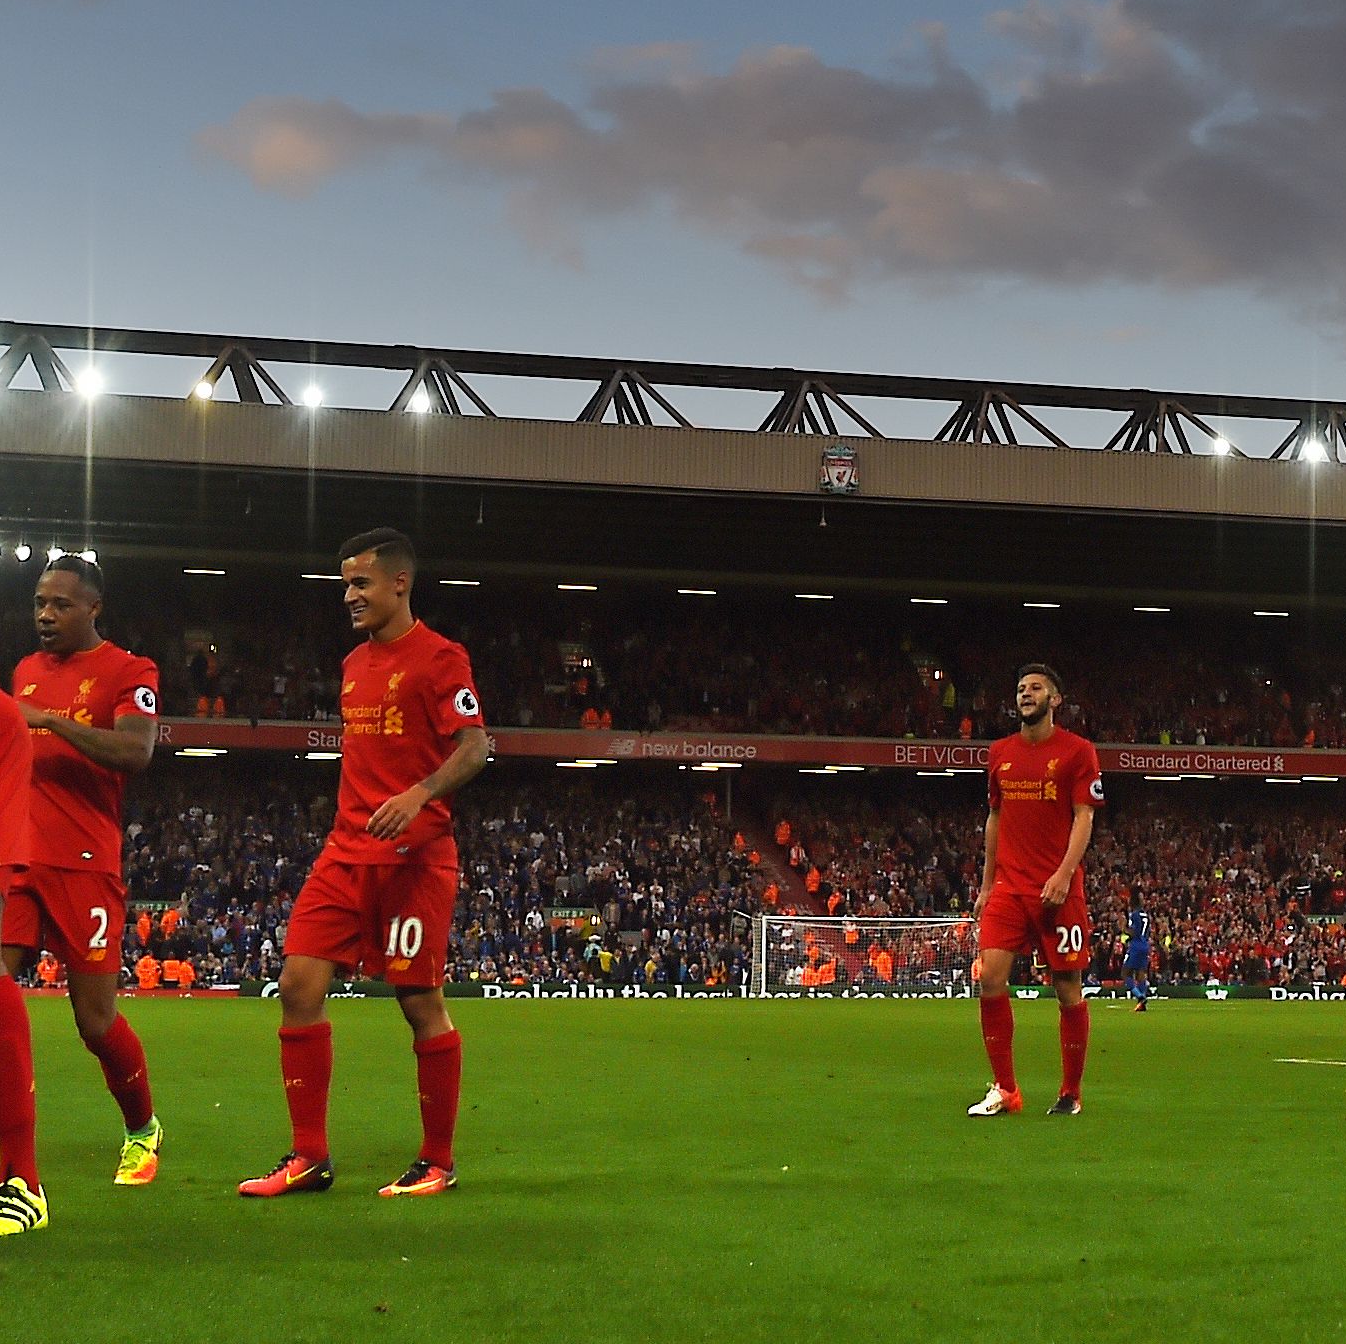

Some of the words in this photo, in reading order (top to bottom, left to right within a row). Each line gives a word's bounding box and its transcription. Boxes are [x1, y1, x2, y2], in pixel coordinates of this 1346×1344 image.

[642, 743, 679, 756] new
[683, 741, 757, 758] balance
[895, 745, 989, 765] BETVICTO
[1119, 752, 1190, 769] Standard
[1195, 754, 1271, 771] Chartered
[1000, 780, 1042, 789] Standard
[89, 907, 108, 948] 2
[1141, 917, 1149, 936] 7
[385, 915, 424, 958] 10
[1056, 925, 1083, 953] 20
